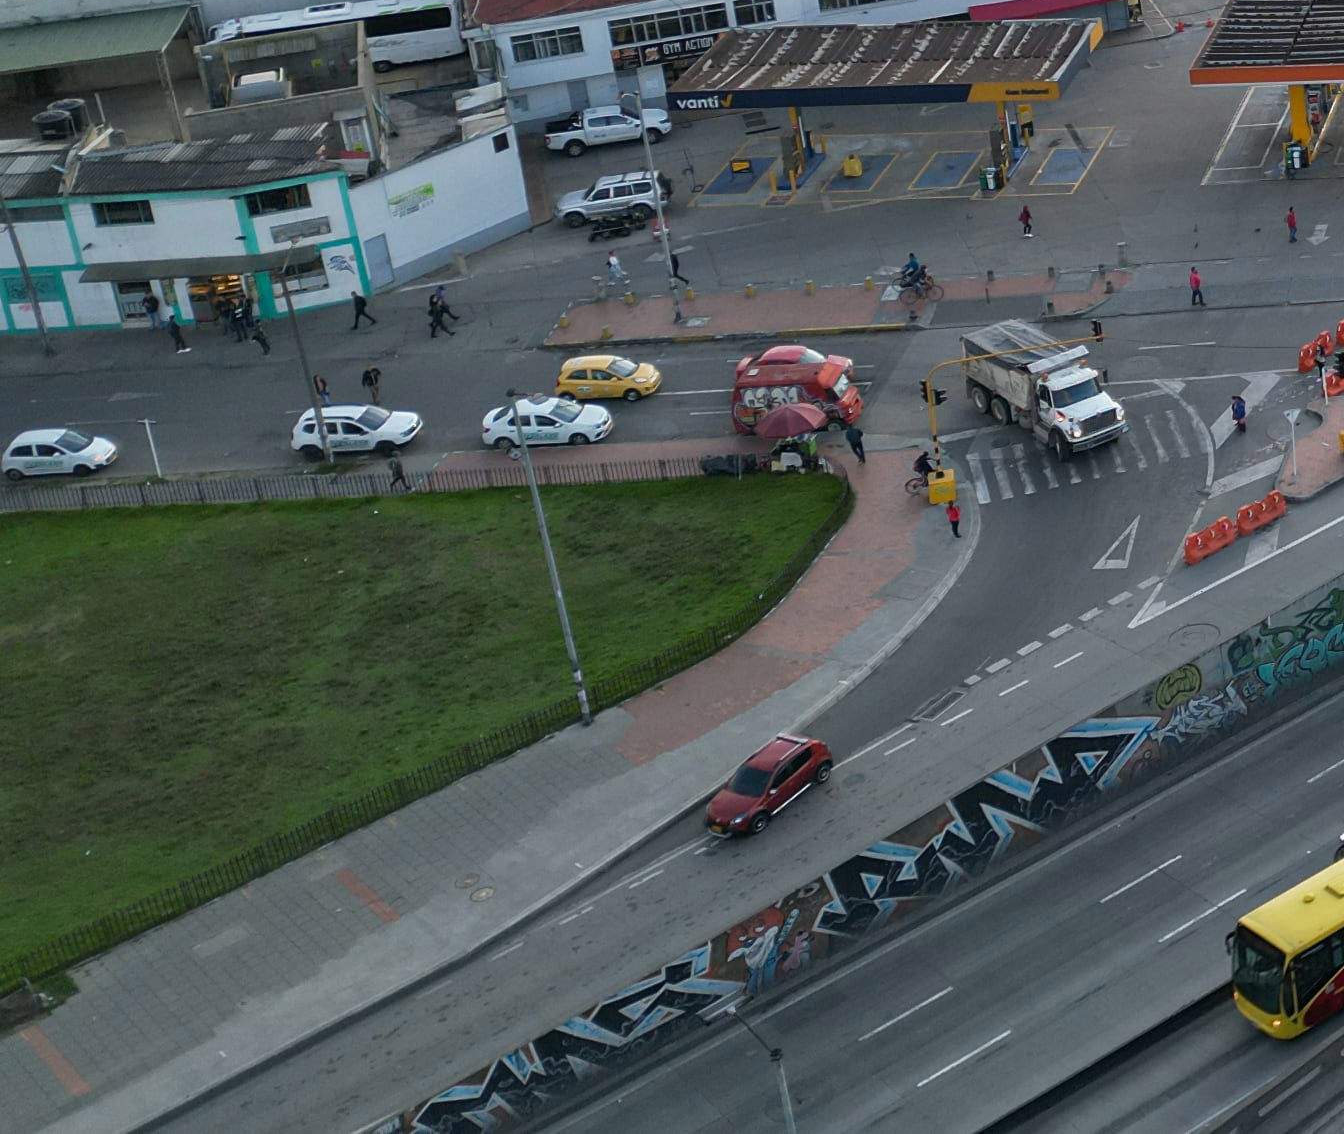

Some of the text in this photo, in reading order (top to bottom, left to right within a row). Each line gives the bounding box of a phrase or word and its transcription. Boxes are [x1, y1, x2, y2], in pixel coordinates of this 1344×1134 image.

[662, 36, 714, 55] GYM ACTION
[676, 95, 719, 109] vanti
